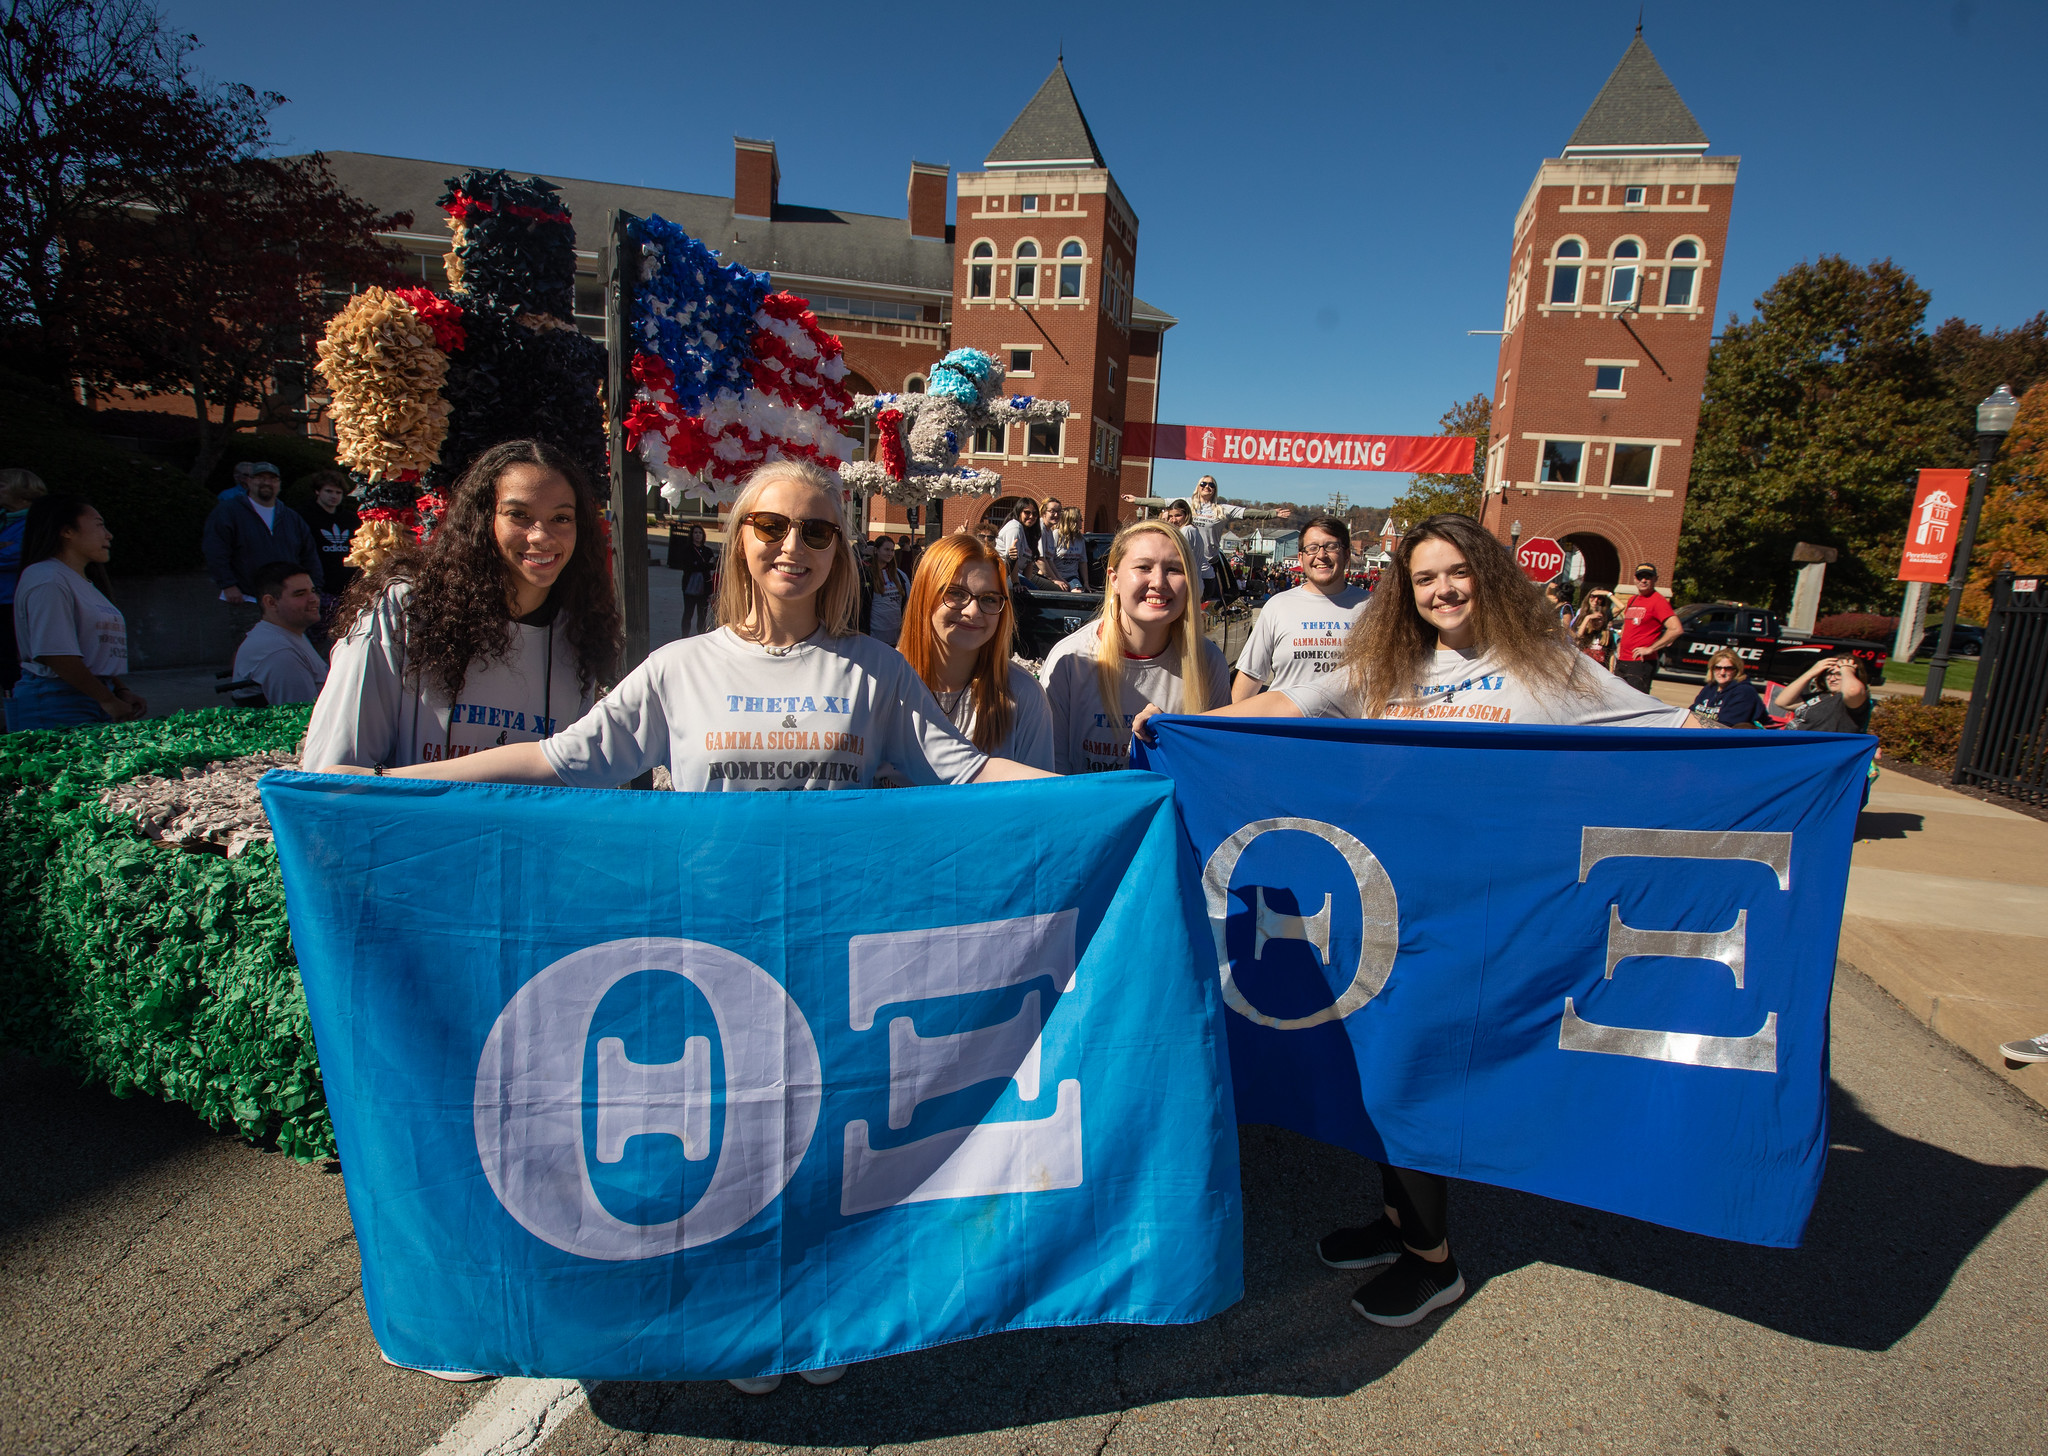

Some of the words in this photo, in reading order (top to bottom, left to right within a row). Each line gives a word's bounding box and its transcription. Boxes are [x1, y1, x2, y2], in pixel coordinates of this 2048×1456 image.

[1223, 435, 1386, 466] HOMECOMING
[322, 544, 349, 552] adida
[1519, 550, 1561, 570] STOP
[1301, 621, 1341, 630] THETA
[1293, 638, 1319, 647] GAMMA
[1320, 638, 1342, 647] SIGMA
[1852, 649, 1875, 660] K-9
[1477, 676, 1505, 690] XI
[727, 695, 817, 712] THETA
[823, 696, 851, 714] XI
[448, 703, 525, 731] THETA
[531, 714, 557, 737] XI
[782, 714, 797, 728] &
[1385, 704, 1427, 718] GAMMA
[1427, 704, 1467, 718] SIGMA
[1466, 704, 1511, 724] SIGMA
[496, 730, 508, 745] &
[705, 731, 764, 750] GAMMA
[768, 731, 820, 750] SIGMA
[824, 731, 864, 756] SIGMA
[1083, 739, 1118, 757] GAMMA
